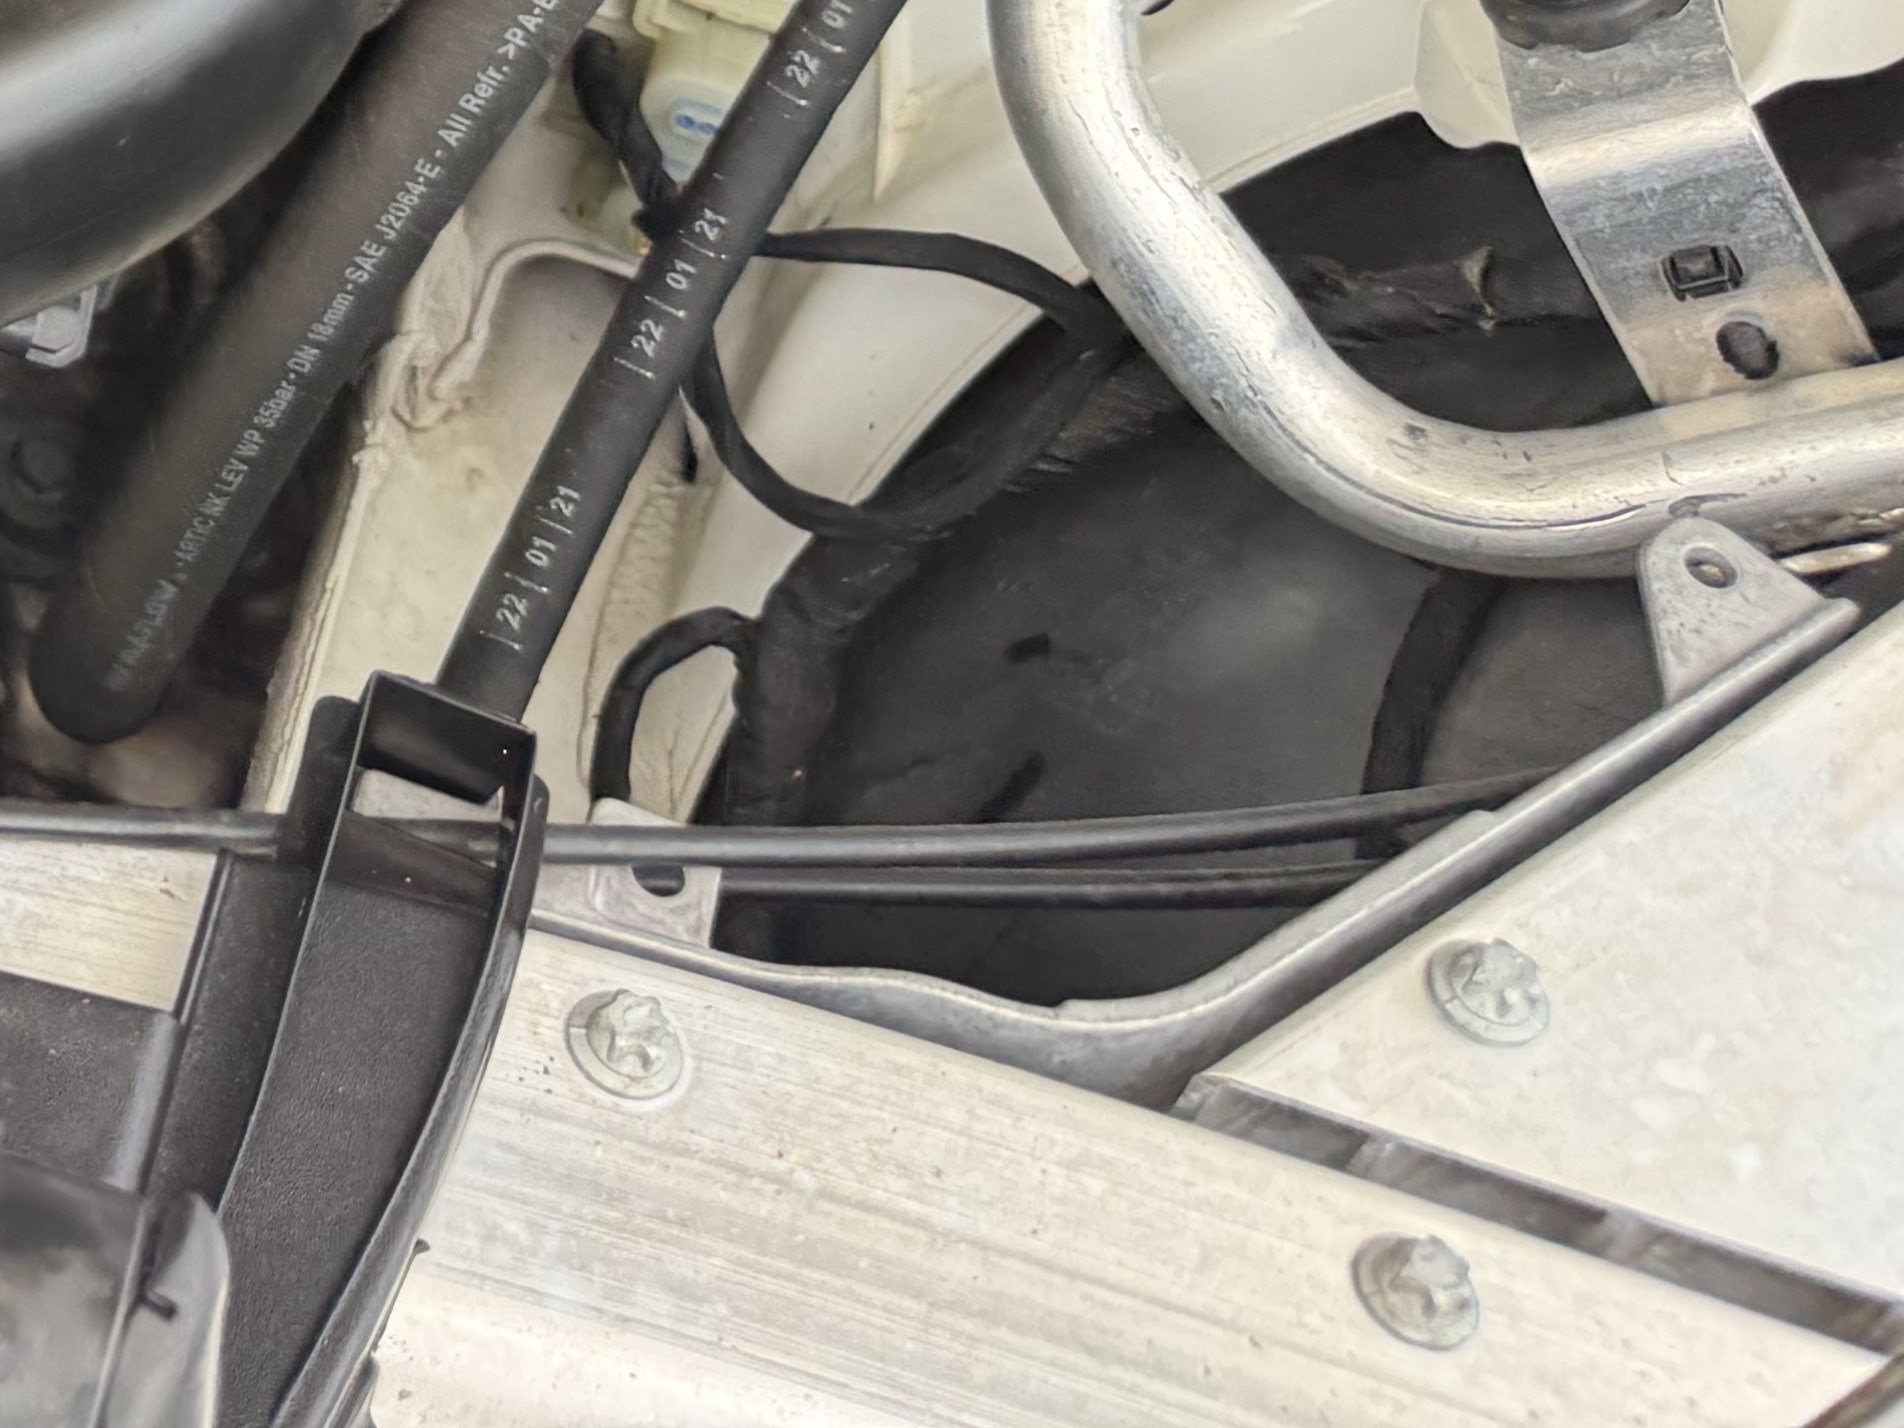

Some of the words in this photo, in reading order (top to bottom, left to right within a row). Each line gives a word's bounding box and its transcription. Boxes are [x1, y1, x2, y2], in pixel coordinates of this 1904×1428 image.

[214, 457, 249, 493] LEV
[234, 429, 265, 457] WP
[344, 239, 387, 284] SAE
[437, 113, 473, 148] All
[458, 65, 510, 114] Refr.
